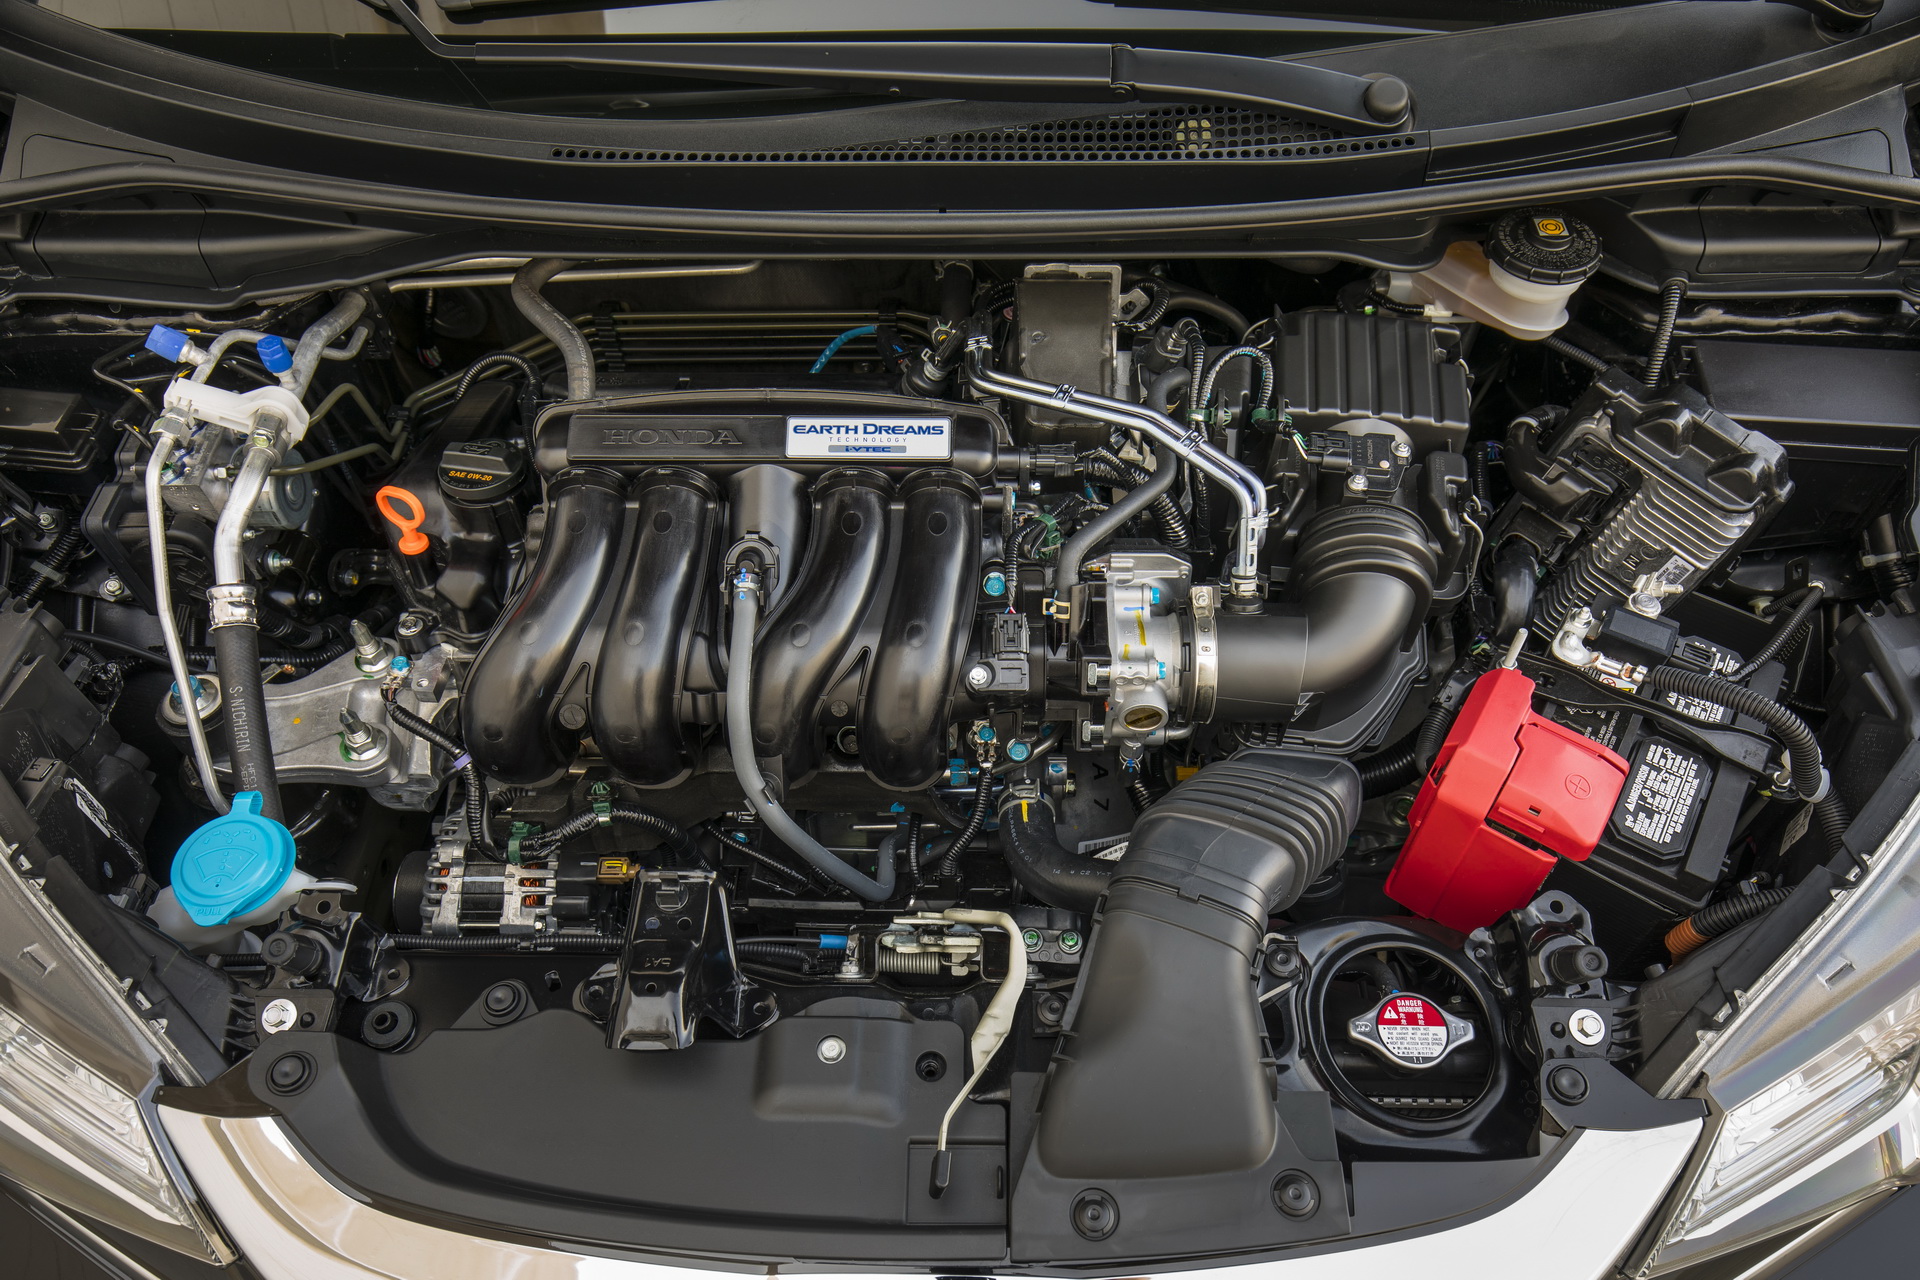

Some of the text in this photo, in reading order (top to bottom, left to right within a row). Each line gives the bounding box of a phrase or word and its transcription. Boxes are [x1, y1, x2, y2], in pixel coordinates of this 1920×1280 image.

[793, 423, 944, 435] EARTH DREAMS
[603, 429, 742, 446] HONDA
[448, 470, 493, 482] SAE 0W-20
